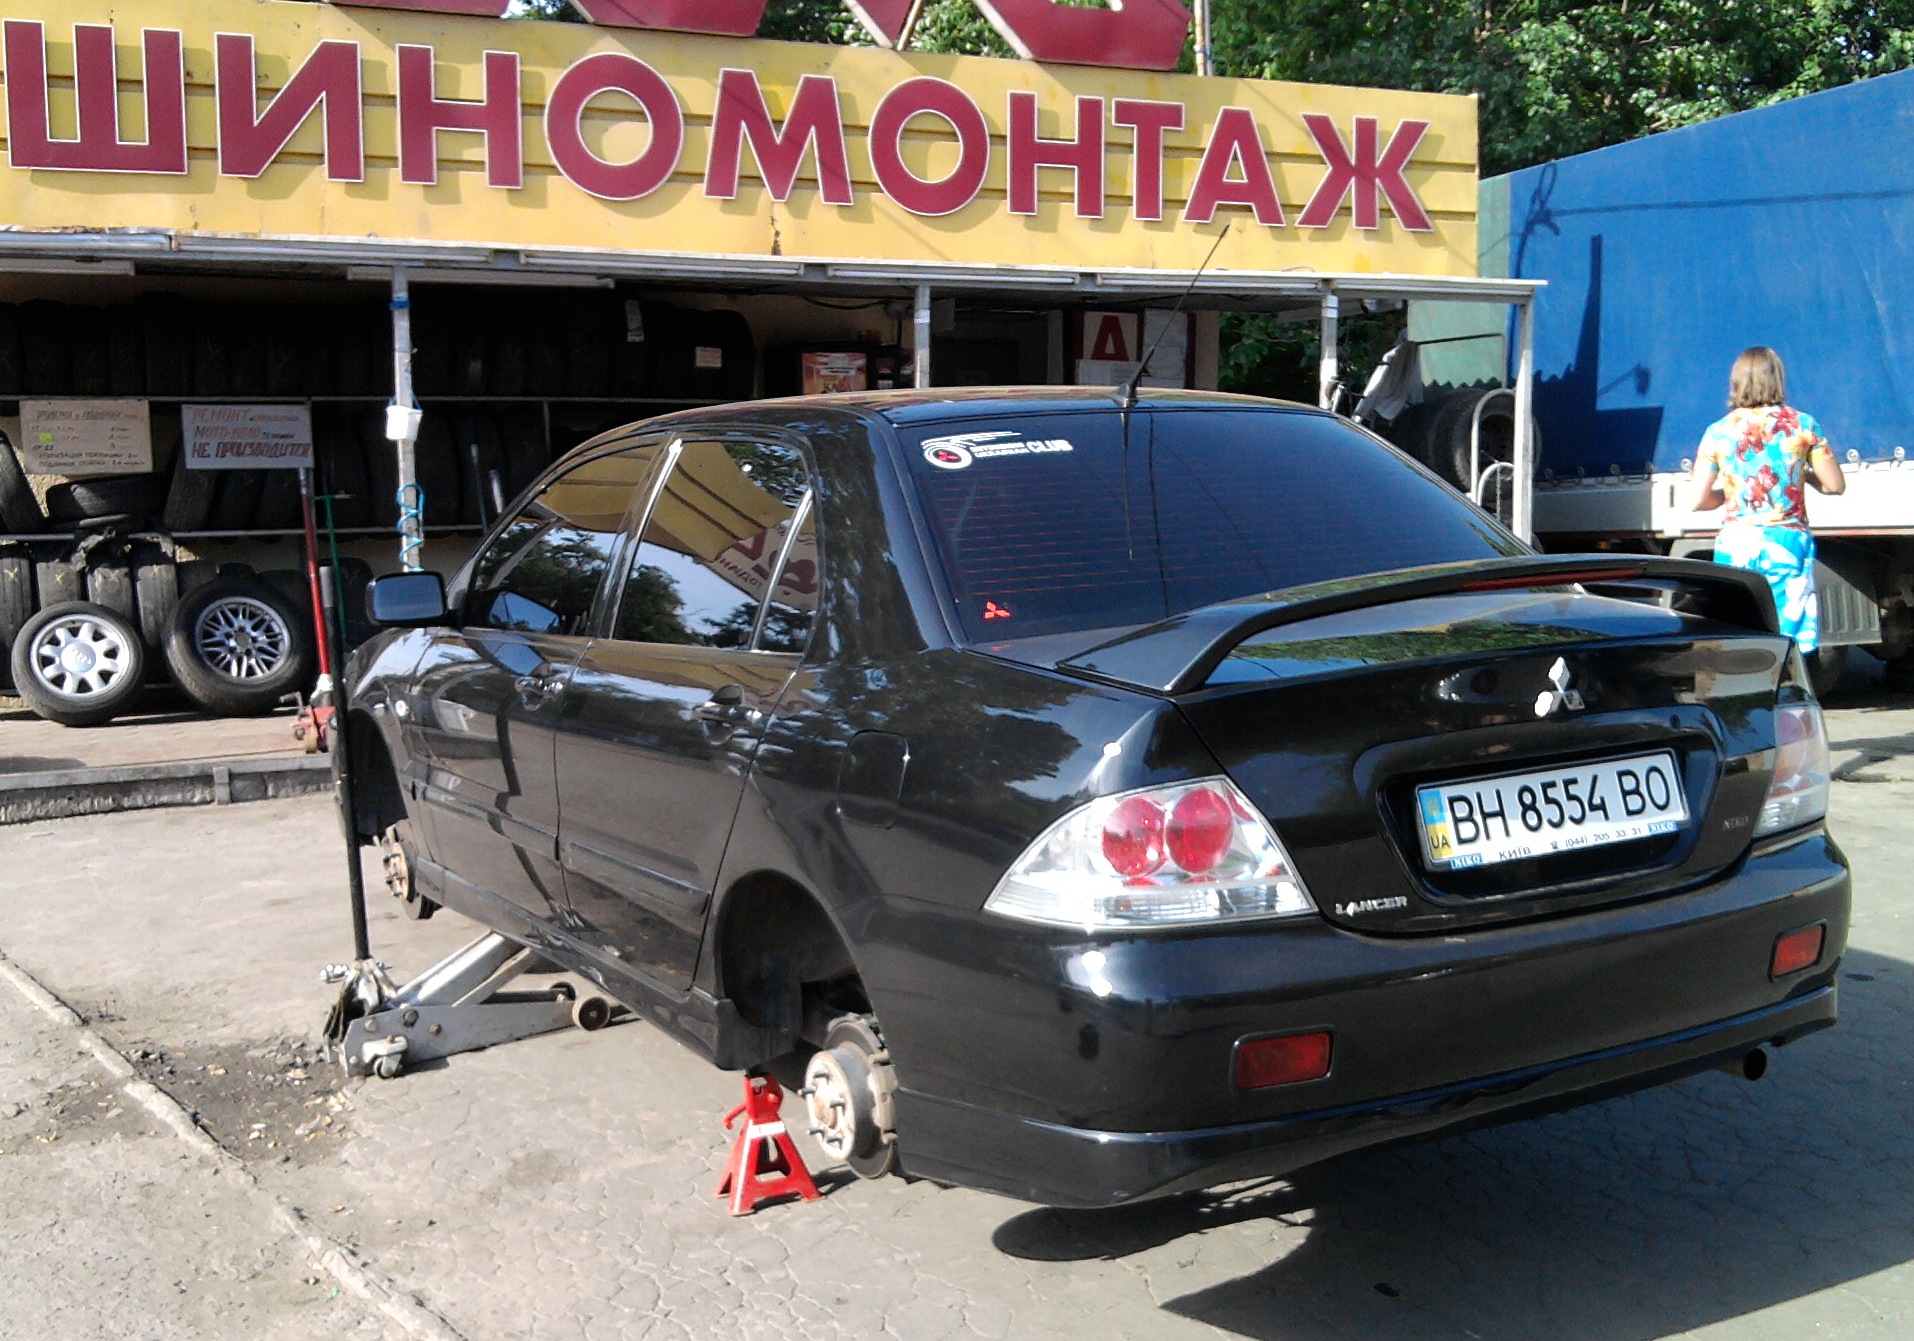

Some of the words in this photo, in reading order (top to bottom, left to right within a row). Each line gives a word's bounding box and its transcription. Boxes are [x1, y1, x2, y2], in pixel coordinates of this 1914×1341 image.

[3, 18, 1434, 233] ШИНОМОНТАЖ
[192, 441, 211, 458] НЕ
[1026, 439, 1074, 453] CLUB
[1447, 788, 1511, 846] BH
[1517, 774, 1610, 833] 8554
[1430, 835, 1450, 850] UA
[1335, 895, 1408, 917] LANCER
